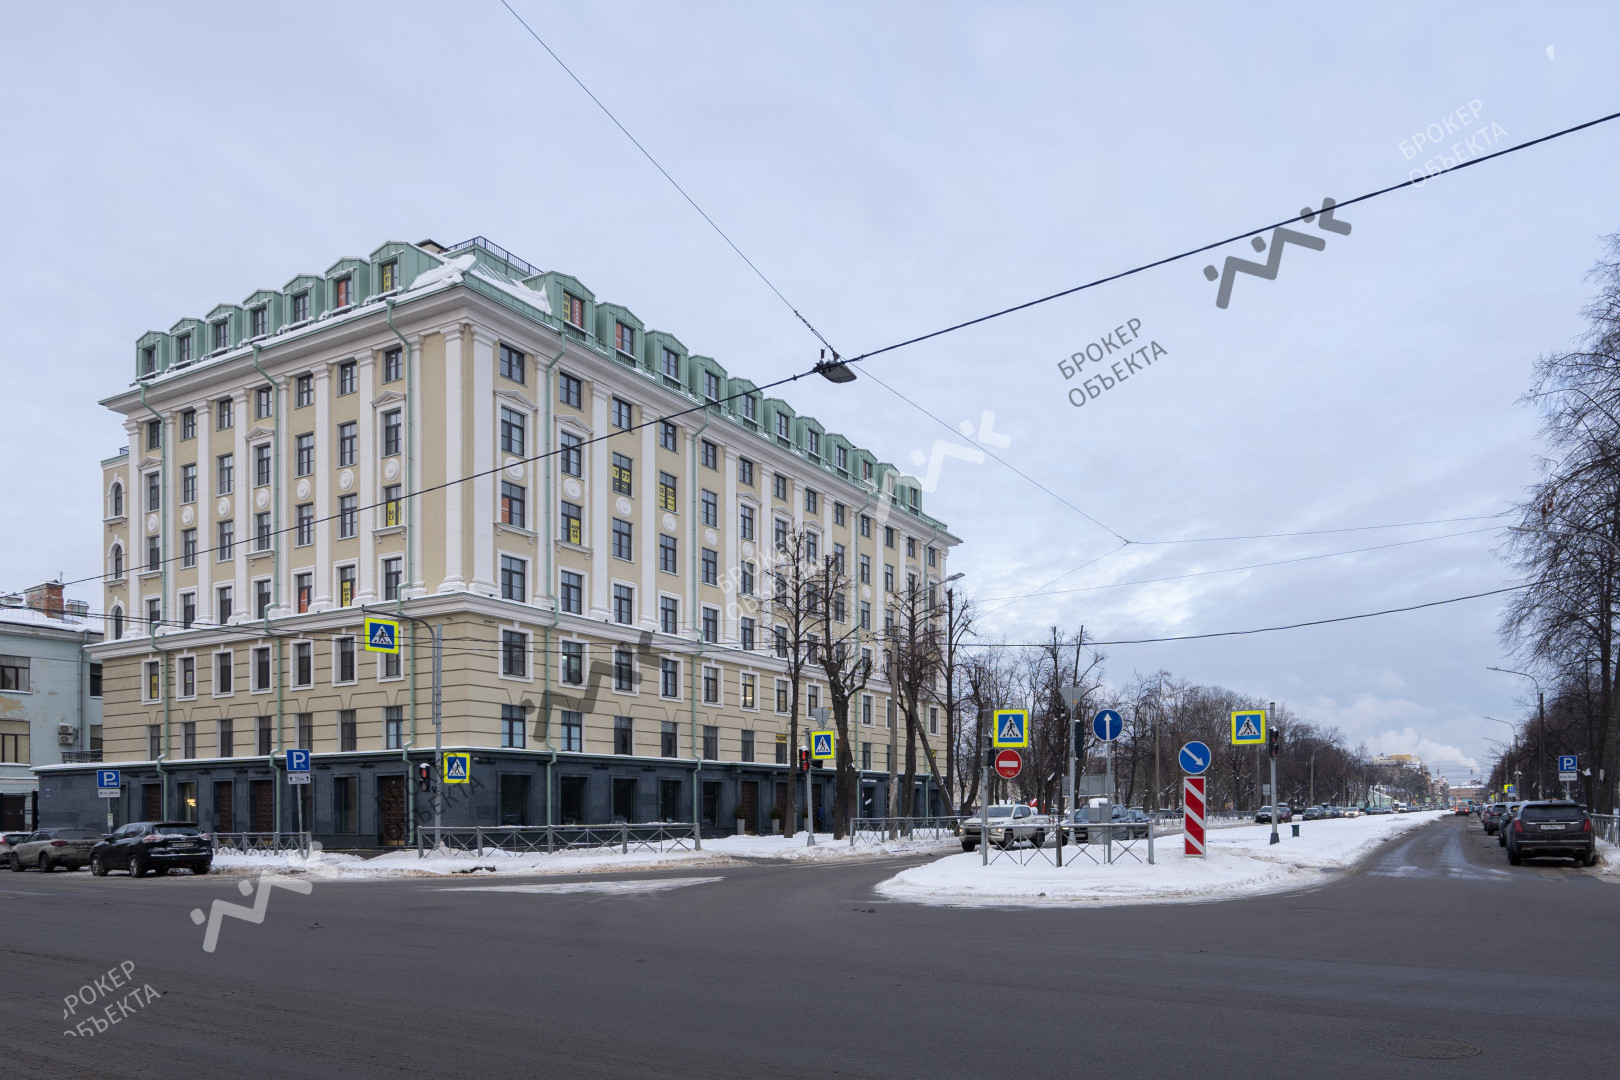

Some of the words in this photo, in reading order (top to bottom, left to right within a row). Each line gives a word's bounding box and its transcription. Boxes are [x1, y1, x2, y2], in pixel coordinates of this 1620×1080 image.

[293, 751, 306, 769] P
[1563, 757, 1574, 770] P
[103, 772, 116, 786] P
